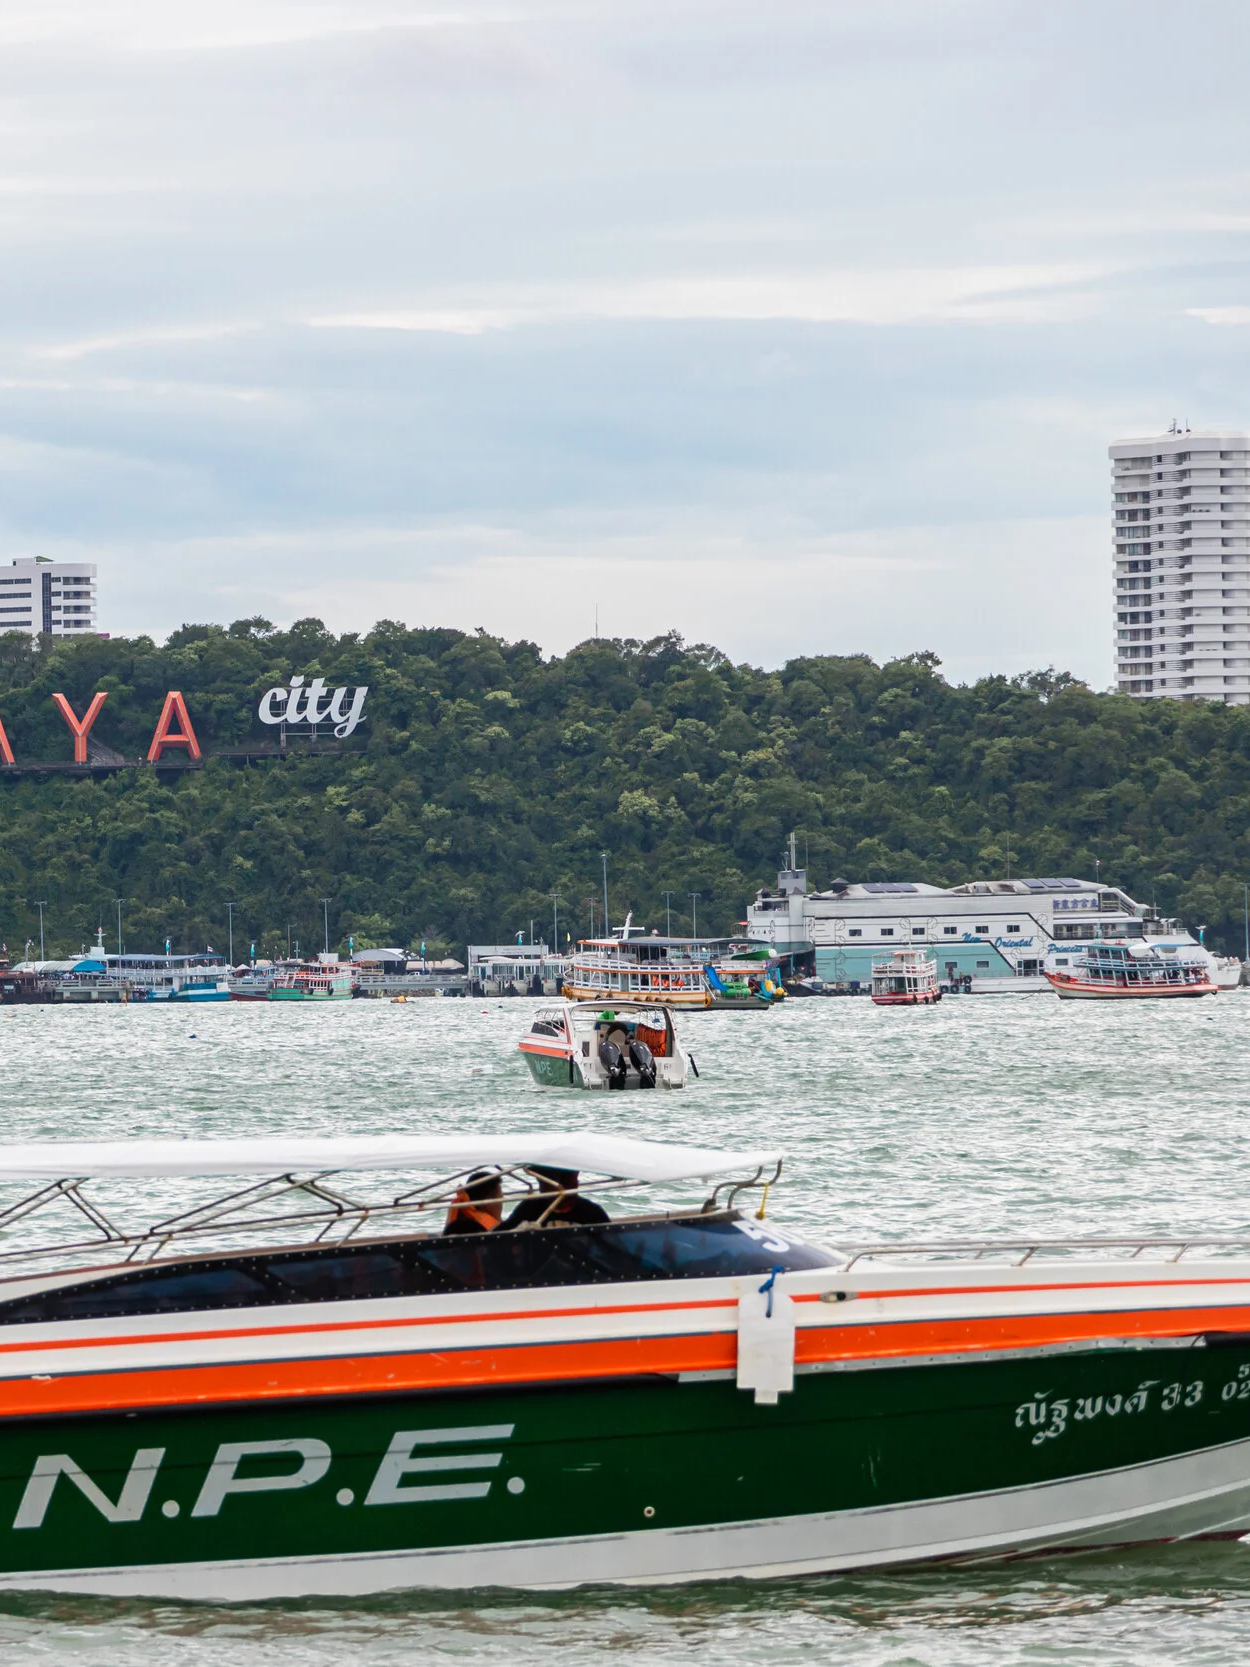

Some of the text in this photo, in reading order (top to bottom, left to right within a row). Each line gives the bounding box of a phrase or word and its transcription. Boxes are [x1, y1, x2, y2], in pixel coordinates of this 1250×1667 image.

[258, 674, 369, 739] city
[994, 935, 1034, 948] Oriental
[1160, 1380, 1204, 1411] 33
[12, 1423, 526, 1530] N.P.E.
